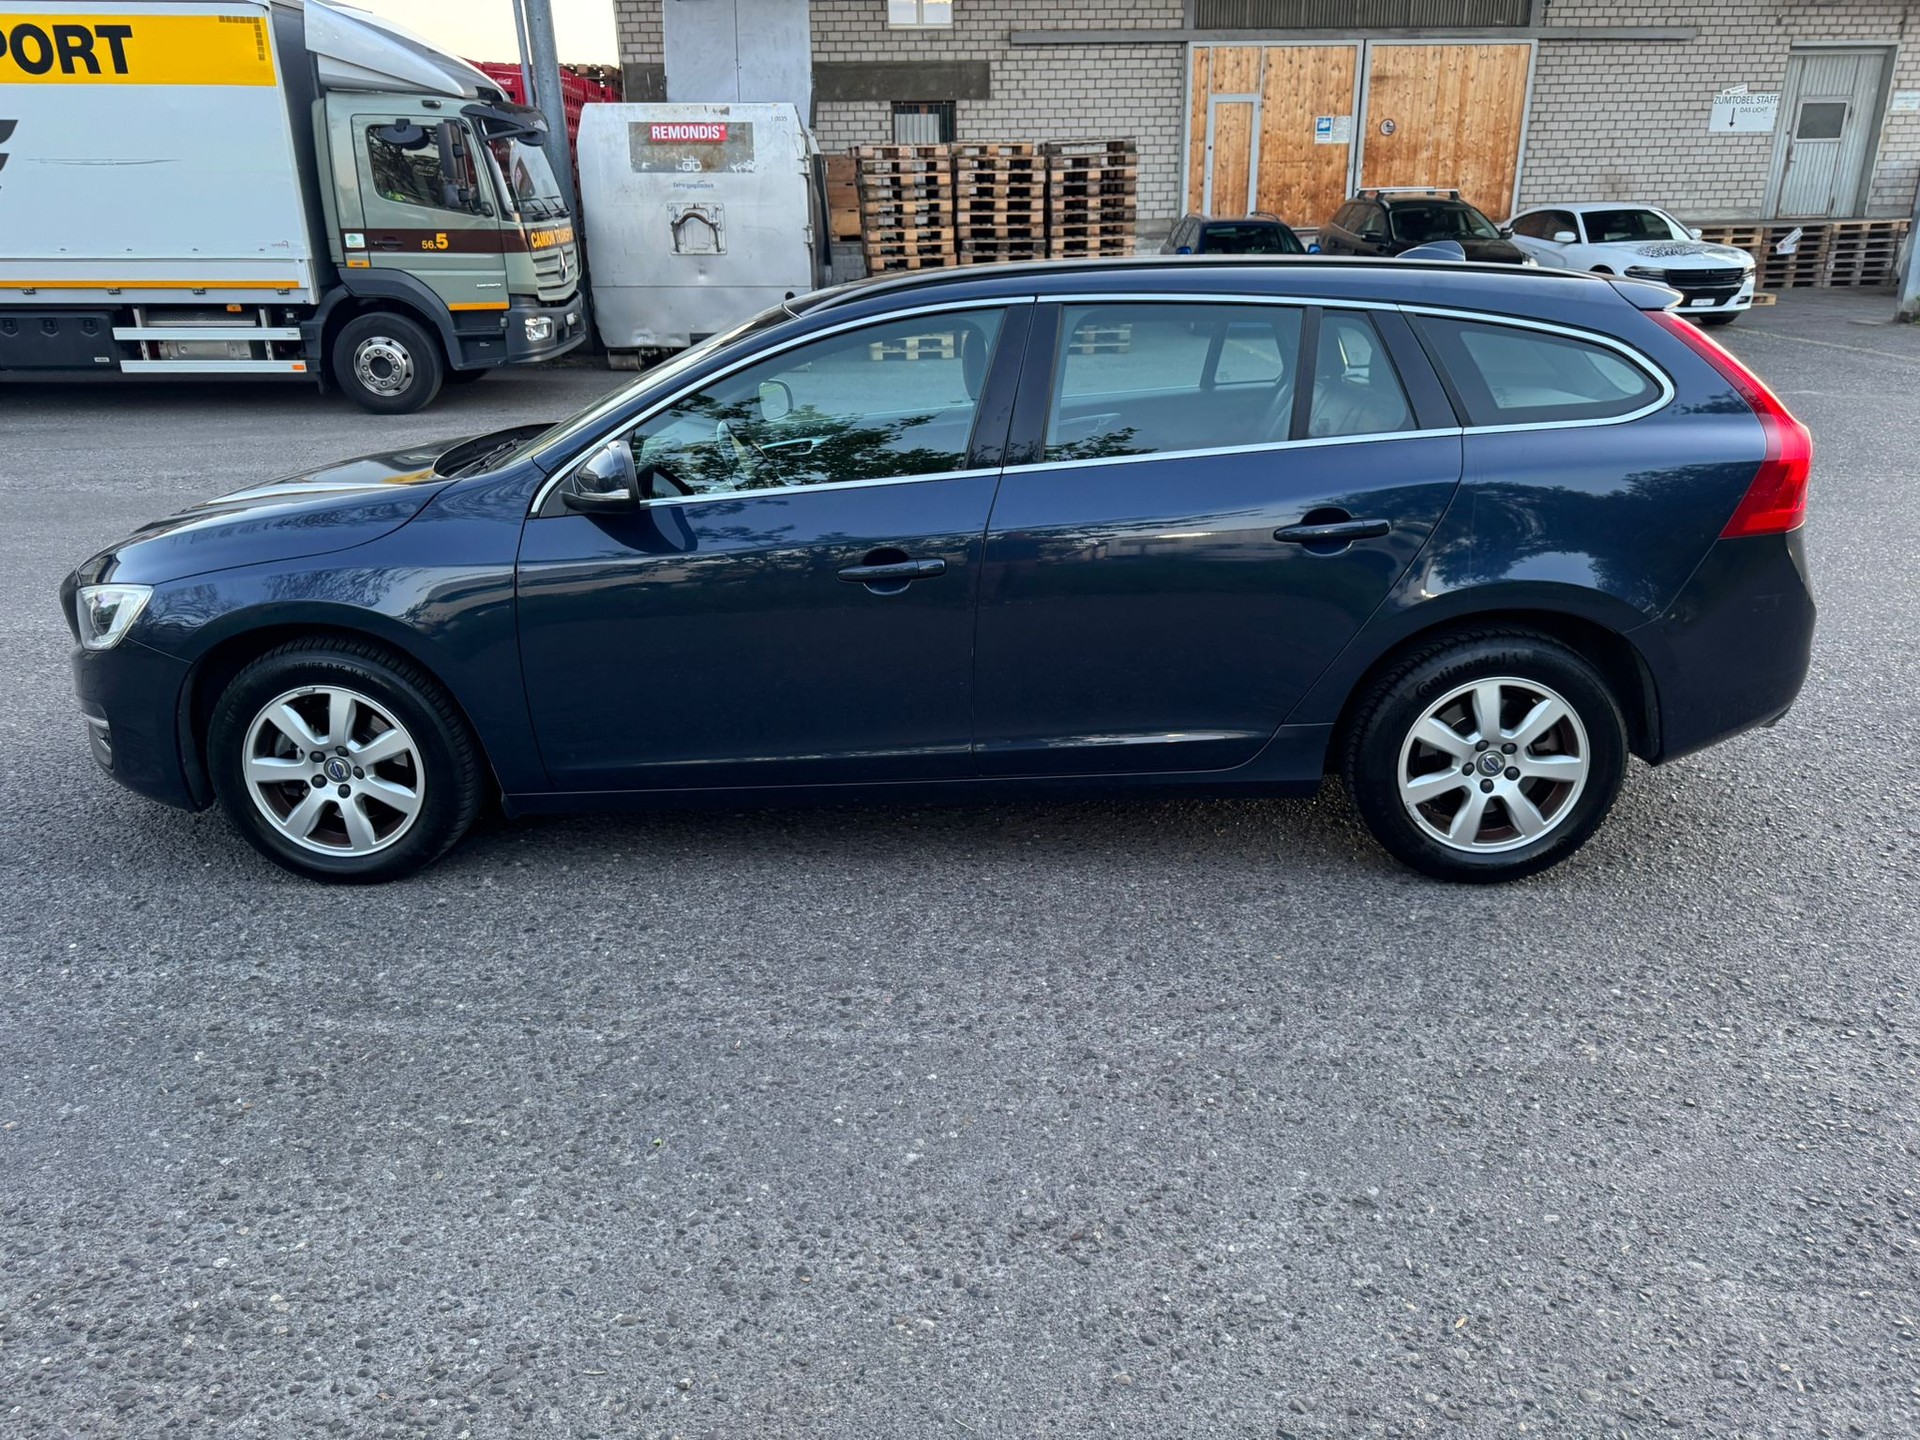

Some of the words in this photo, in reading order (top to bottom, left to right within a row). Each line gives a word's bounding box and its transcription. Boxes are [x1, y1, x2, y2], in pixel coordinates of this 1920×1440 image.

[0, 23, 133, 75] ORT
[1714, 95, 1754, 104] ZUMTOBEL
[1757, 95, 1778, 104] STAFF
[421, 233, 449, 250] 56.5
[531, 230, 556, 249] CAMION
